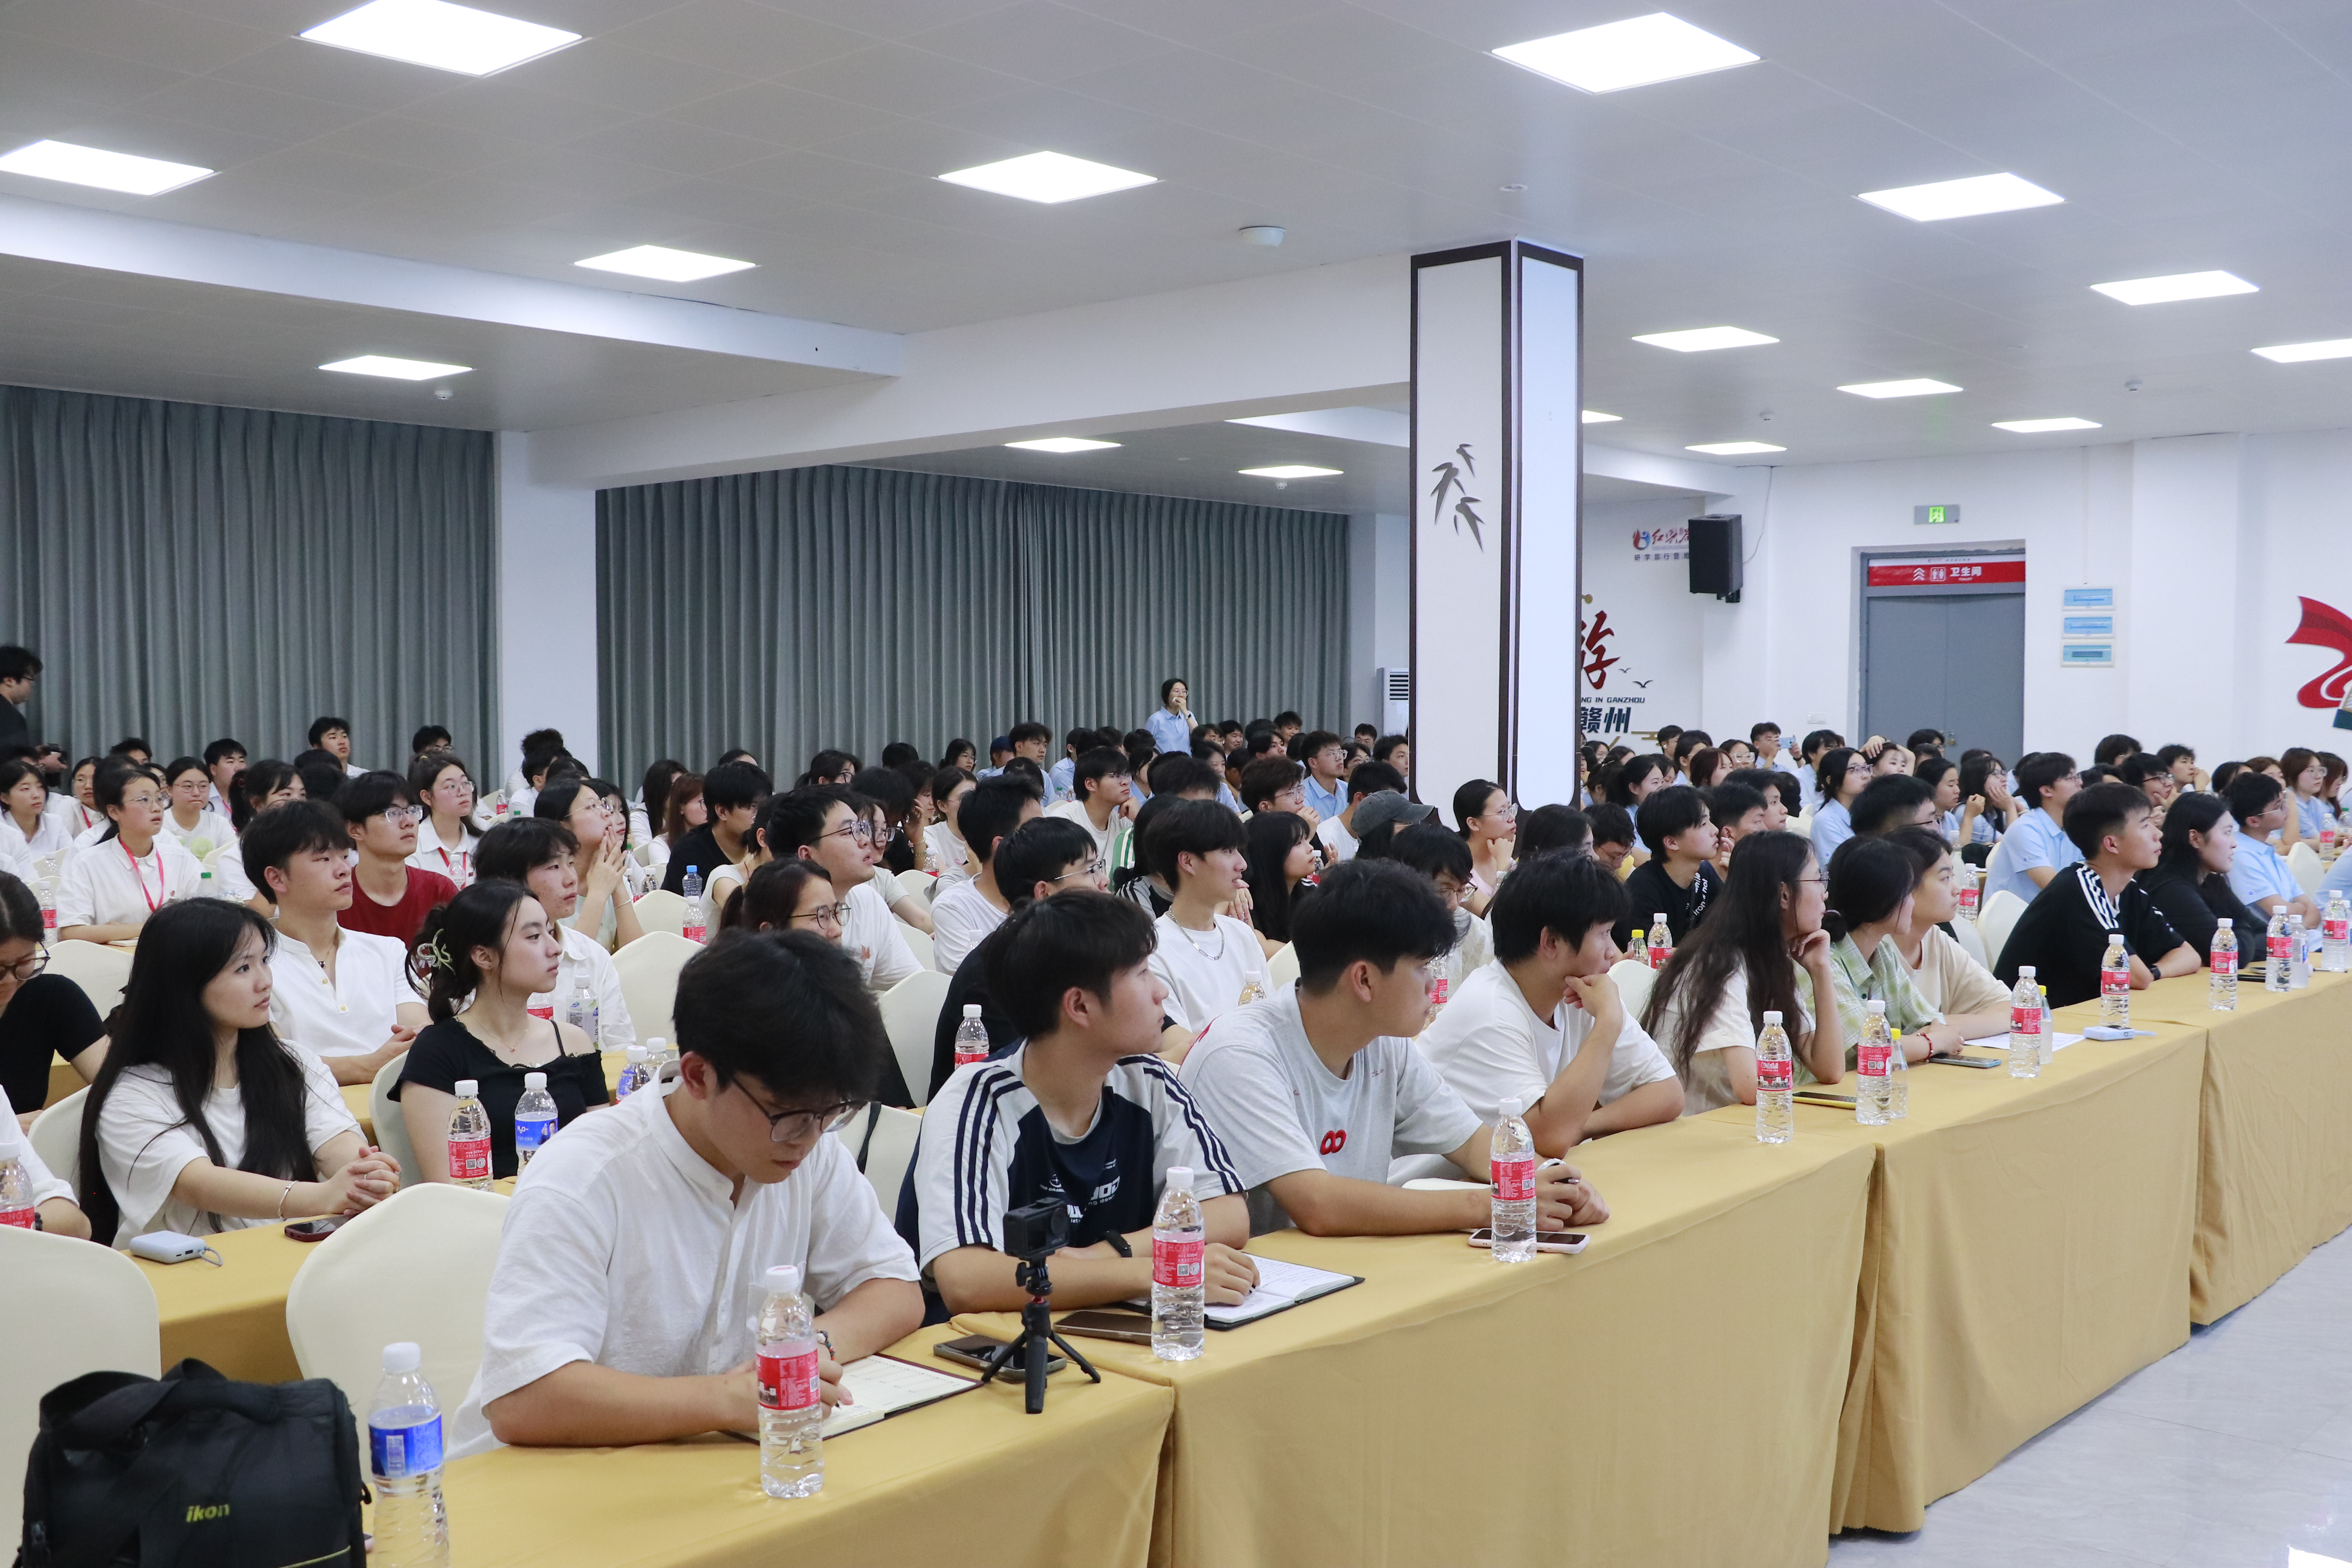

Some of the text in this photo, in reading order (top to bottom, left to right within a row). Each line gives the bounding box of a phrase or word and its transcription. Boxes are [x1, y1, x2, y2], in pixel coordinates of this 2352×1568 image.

[1634, 552, 1690, 561] 研学旅行营地
[1950, 566, 1982, 577] 卫生间
[1693, 901, 1706, 916] iron
[457, 1142, 481, 1150] HONG
